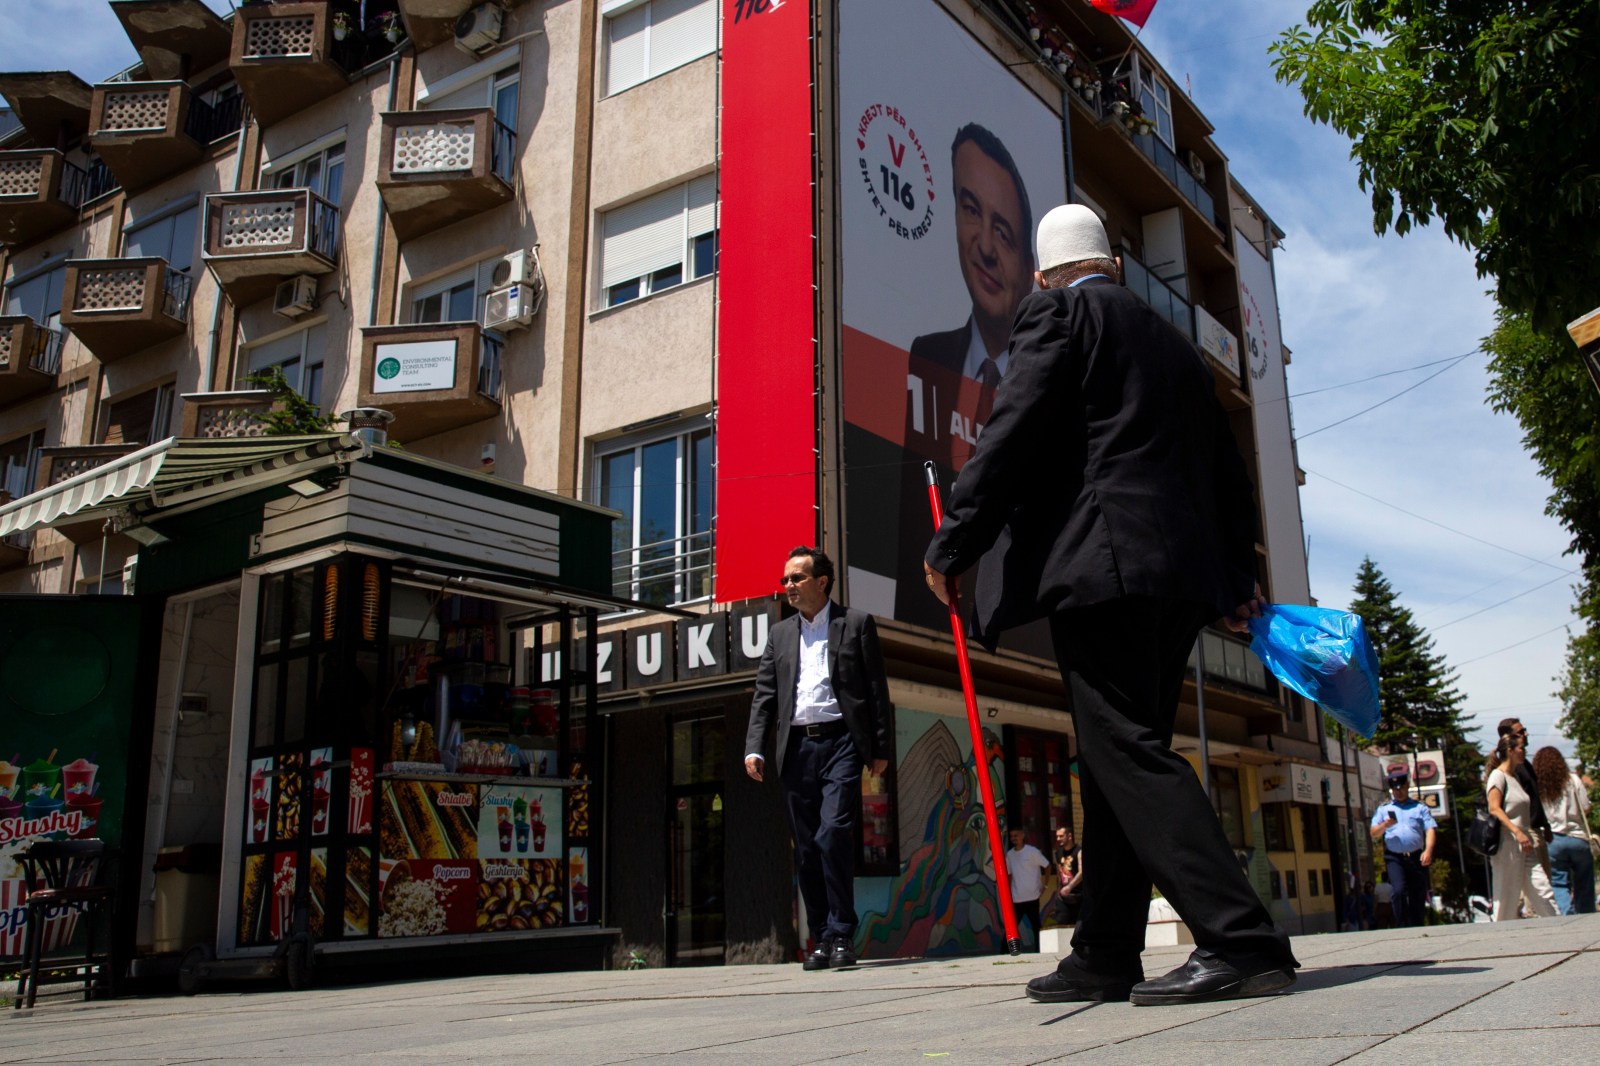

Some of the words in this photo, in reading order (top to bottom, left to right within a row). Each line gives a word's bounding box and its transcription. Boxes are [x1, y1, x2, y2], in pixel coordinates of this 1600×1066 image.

[858, 104, 882, 137] KREJT
[886, 105, 907, 129] PËR
[908, 128, 934, 187] SHTET
[887, 133, 906, 169] V
[858, 157, 887, 217] SHTET
[889, 217, 910, 240] PËR
[911, 204, 934, 241] KREJT
[880, 164, 915, 211] 116
[402, 355, 453, 365] ENVIRONMENTAL
[402, 362, 439, 370] CONSULTING
[907, 373, 925, 435] 1
[253, 534, 261, 555] 5
[485, 793, 514, 807] Slushy
[0, 809, 82, 841] Slushy
[433, 865, 470, 881] Popcorn
